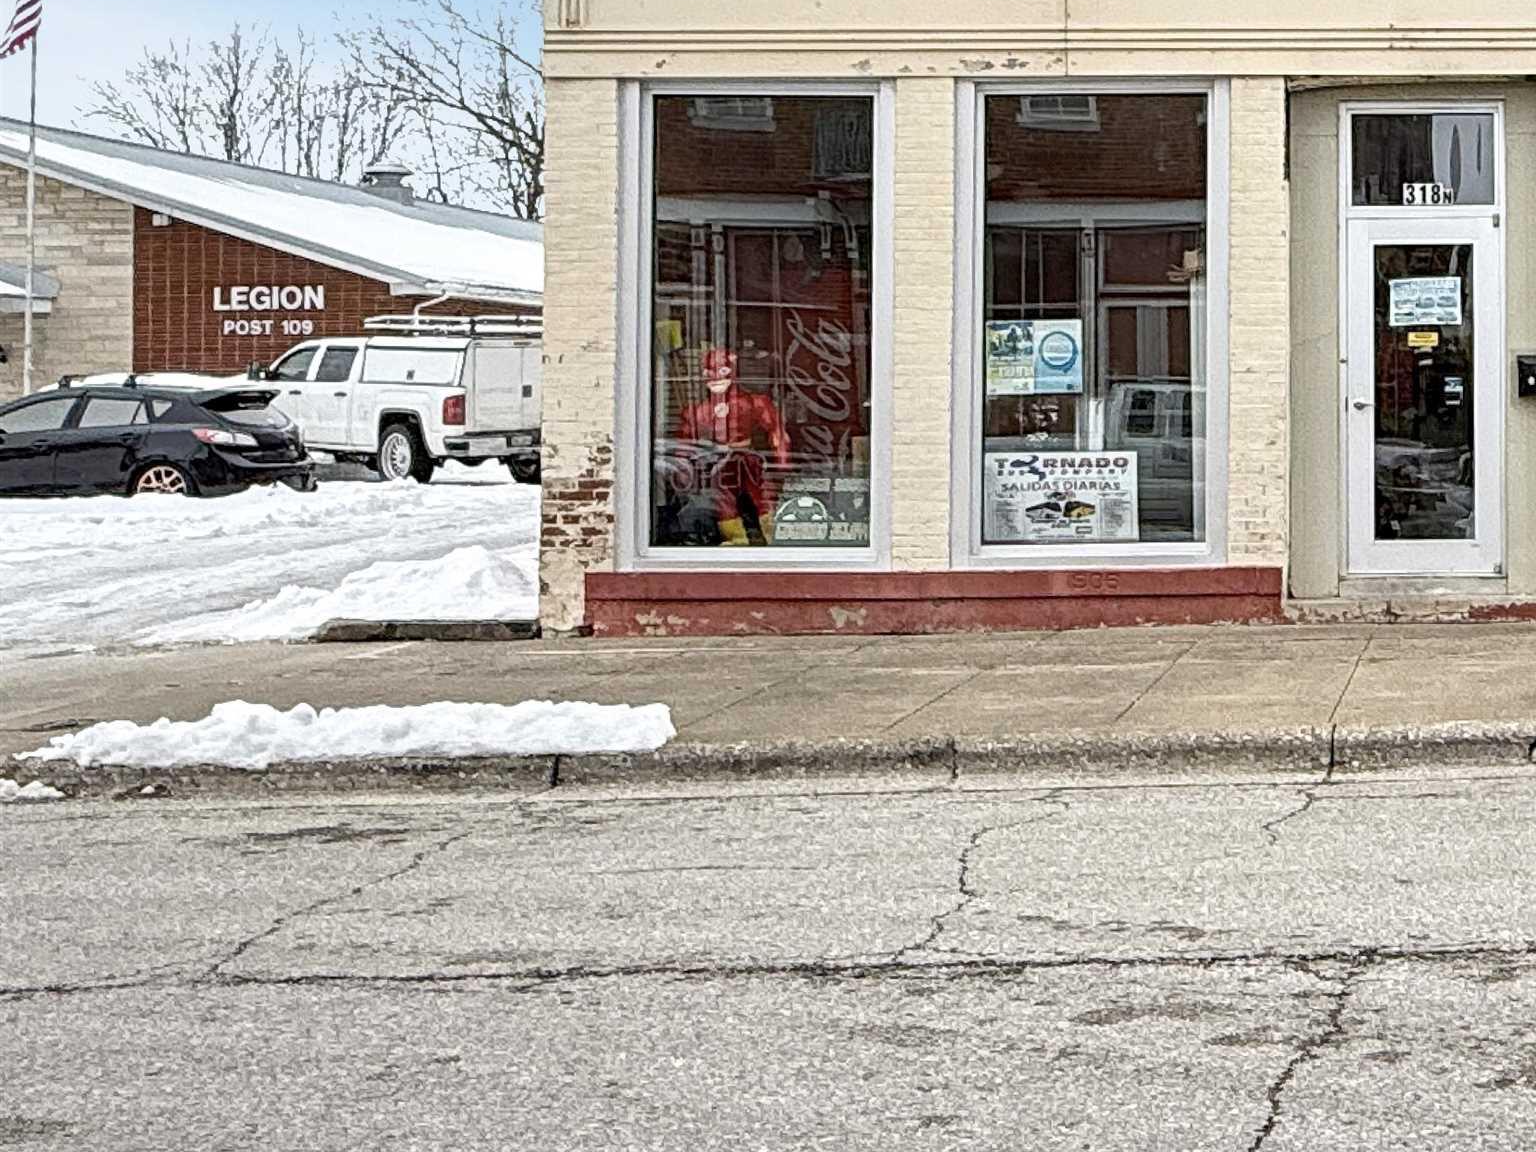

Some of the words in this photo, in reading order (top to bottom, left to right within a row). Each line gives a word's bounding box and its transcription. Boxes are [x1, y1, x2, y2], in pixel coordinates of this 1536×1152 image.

[213, 285, 325, 311] LEGION
[223, 319, 273, 336] POST
[280, 319, 314, 336] 109
[1000, 481, 1060, 492] SALIDAS
[1062, 480, 1121, 491] DIARIAS
